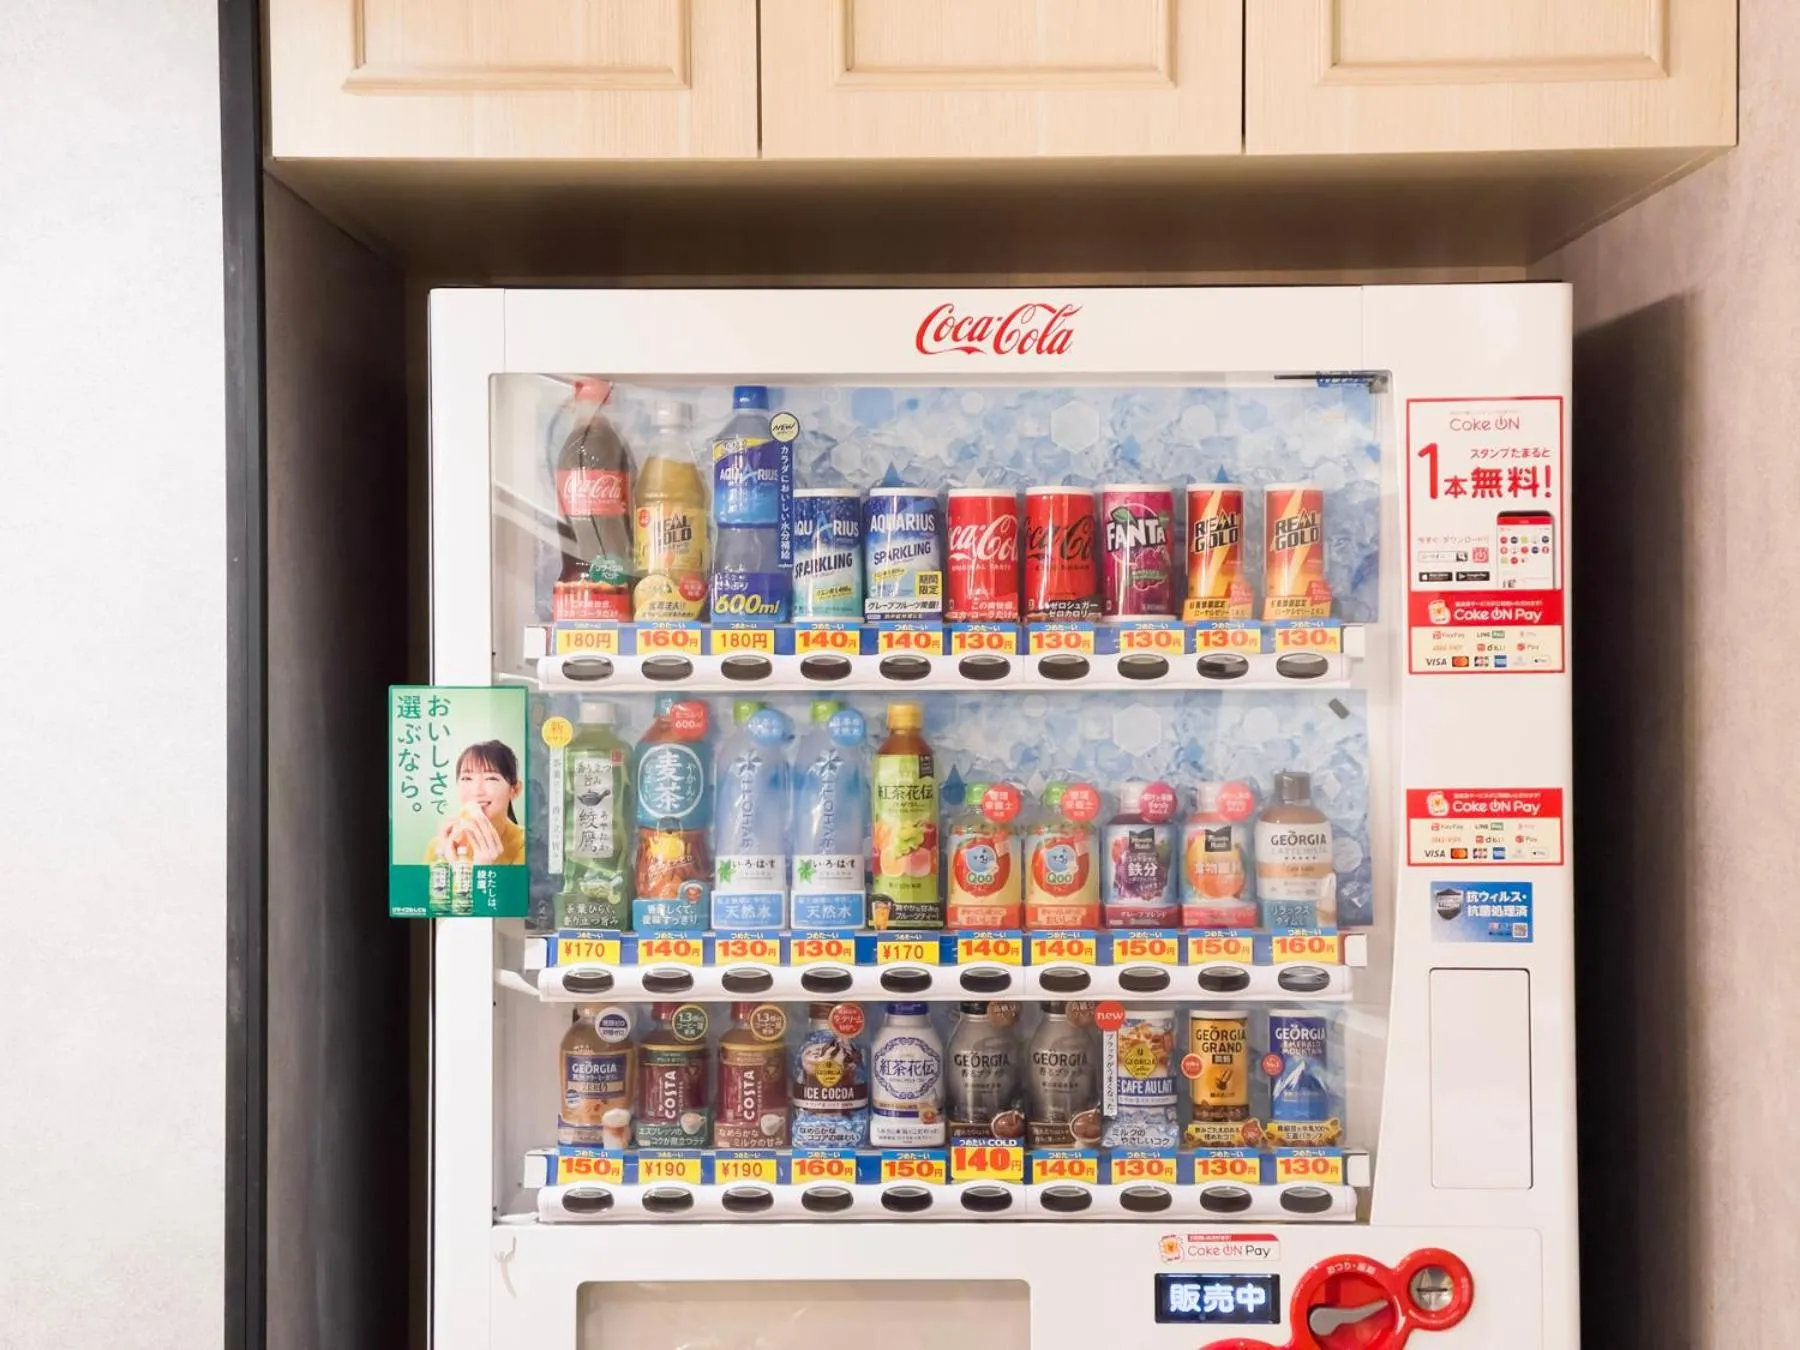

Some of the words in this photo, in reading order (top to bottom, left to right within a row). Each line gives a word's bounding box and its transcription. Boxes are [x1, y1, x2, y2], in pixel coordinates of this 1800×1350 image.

[915, 303, 1083, 356] Coca-Cola
[773, 422, 796, 432] NEW
[1450, 418, 1490, 431] Coke
[1495, 416, 1520, 430] ON
[1470, 448, 1551, 459] スタンプたまると
[1418, 442, 1552, 499] 1本無料!
[780, 446, 791, 559] カラダにおいしい水分補給
[870, 514, 935, 533] AQUARIUS
[1194, 509, 1241, 536] REAL
[1274, 509, 1321, 535] REAL
[1106, 518, 1168, 552] FANTA
[1194, 526, 1240, 552] GOLD
[1274, 525, 1320, 551] GOLD
[874, 541, 931, 566] SPARKLING
[795, 552, 853, 578] SPARKLING
[918, 574, 938, 585] 期間
[918, 585, 939, 595] 限定
[715, 593, 780, 615] 600ml
[1454, 609, 1489, 621] Coke
[1491, 607, 1513, 620] ON
[1515, 608, 1542, 623] Pay
[565, 633, 611, 649] 180円
[639, 629, 698, 648] 160円
[720, 632, 768, 649] 180円
[799, 631, 857, 649] 140円
[883, 631, 940, 649] 140円
[955, 631, 1012, 649] 130円
[1033, 631, 1091, 649] 130円
[1123, 630, 1181, 648] 130円
[1199, 629, 1257, 647] 130円
[1278, 629, 1337, 646] 130円
[1426, 657, 1447, 666] VISA
[396, 695, 422, 812] 選ぶなら。
[427, 695, 451, 815] おいしさで
[654, 749, 685, 812] 麦茶
[878, 784, 934, 802] 紅茶花伝
[1453, 800, 1487, 812] Coke
[1489, 799, 1511, 812] ON
[1513, 801, 1541, 816] Pay
[1271, 830, 1327, 846] GEORGIA
[1425, 850, 1446, 858] VISA
[967, 873, 993, 884] Qoo
[1047, 873, 1073, 884] Qoo
[1127, 863, 1158, 877] 鉄分
[725, 904, 771, 919] 天然水
[806, 904, 852, 919] 天然水
[564, 943, 606, 958] ¥170
[642, 940, 701, 957] 140円
[718, 940, 776, 957] 130円
[794, 940, 852, 957] 130円
[883, 945, 924, 960] ¥170
[962, 940, 1020, 956] 140円
[1035, 940, 1093, 957] 140円
[1119, 940, 1175, 956] 150円
[1191, 938, 1250, 955] 150円
[1276, 937, 1335, 954] 160円
[1096, 1012, 1124, 1021] new
[1195, 1025, 1247, 1041] GEORGIA
[1275, 1023, 1326, 1041] GEORGIA
[1202, 1042, 1243, 1053] GRAND
[954, 1050, 1010, 1068] GEORGIA
[1032, 1048, 1088, 1067] GEORGIA
[572, 1061, 617, 1075] GEORGIA
[879, 1060, 936, 1077] 紅茶花伝
[664, 1070, 677, 1119] COSTA
[743, 1070, 756, 1120] COSTA
[803, 1087, 819, 1100] ICE
[821, 1086, 855, 1100] COCOA
[1121, 1080, 1144, 1094] CAFE
[1145, 1080, 1157, 1094] AU
[719, 1129, 759, 1138] なめらかな
[733, 1137, 784, 1147] ミルクの甘み
[987, 1139, 1017, 1147] COLD
[562, 1158, 619, 1176] 150円
[794, 1159, 853, 1177] 160円
[954, 1148, 1022, 1171] 140円
[1197, 1159, 1256, 1176] 130円
[1280, 1158, 1339, 1175] 130円
[645, 1162, 686, 1177] ¥190
[721, 1162, 763, 1177] ¥190
[885, 1160, 943, 1177] 150円
[1036, 1160, 1095, 1178] 140円
[1114, 1160, 1173, 1177] 130円
[1188, 1245, 1219, 1256] Coke
[1222, 1244, 1243, 1256] ON
[1245, 1245, 1271, 1258] Pay
[1169, 1283, 1266, 1313] 販売中
